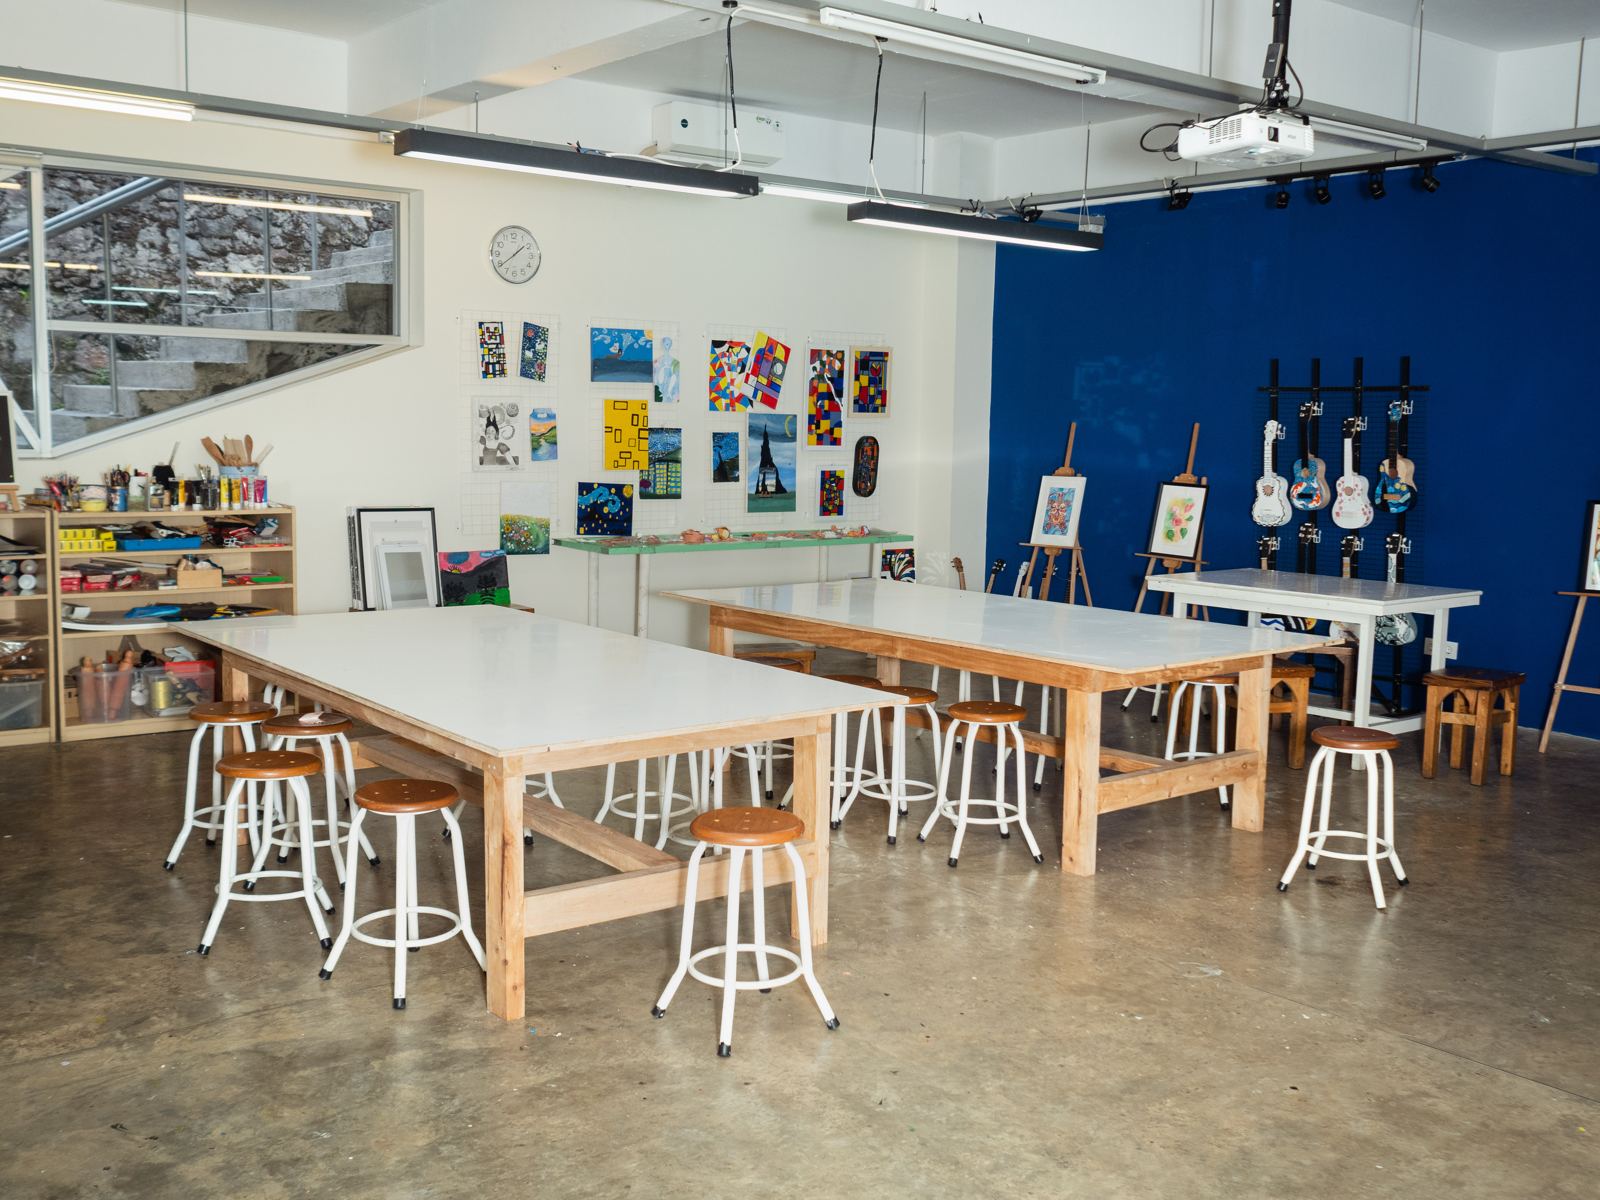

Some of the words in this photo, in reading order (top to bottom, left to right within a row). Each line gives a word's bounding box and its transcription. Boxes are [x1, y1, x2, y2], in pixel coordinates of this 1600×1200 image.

[503, 233, 508, 241] 11
[510, 232, 518, 240] 12
[496, 241, 504, 249] 10
[529, 252, 534, 260] 3
[497, 260, 503, 268] 8
